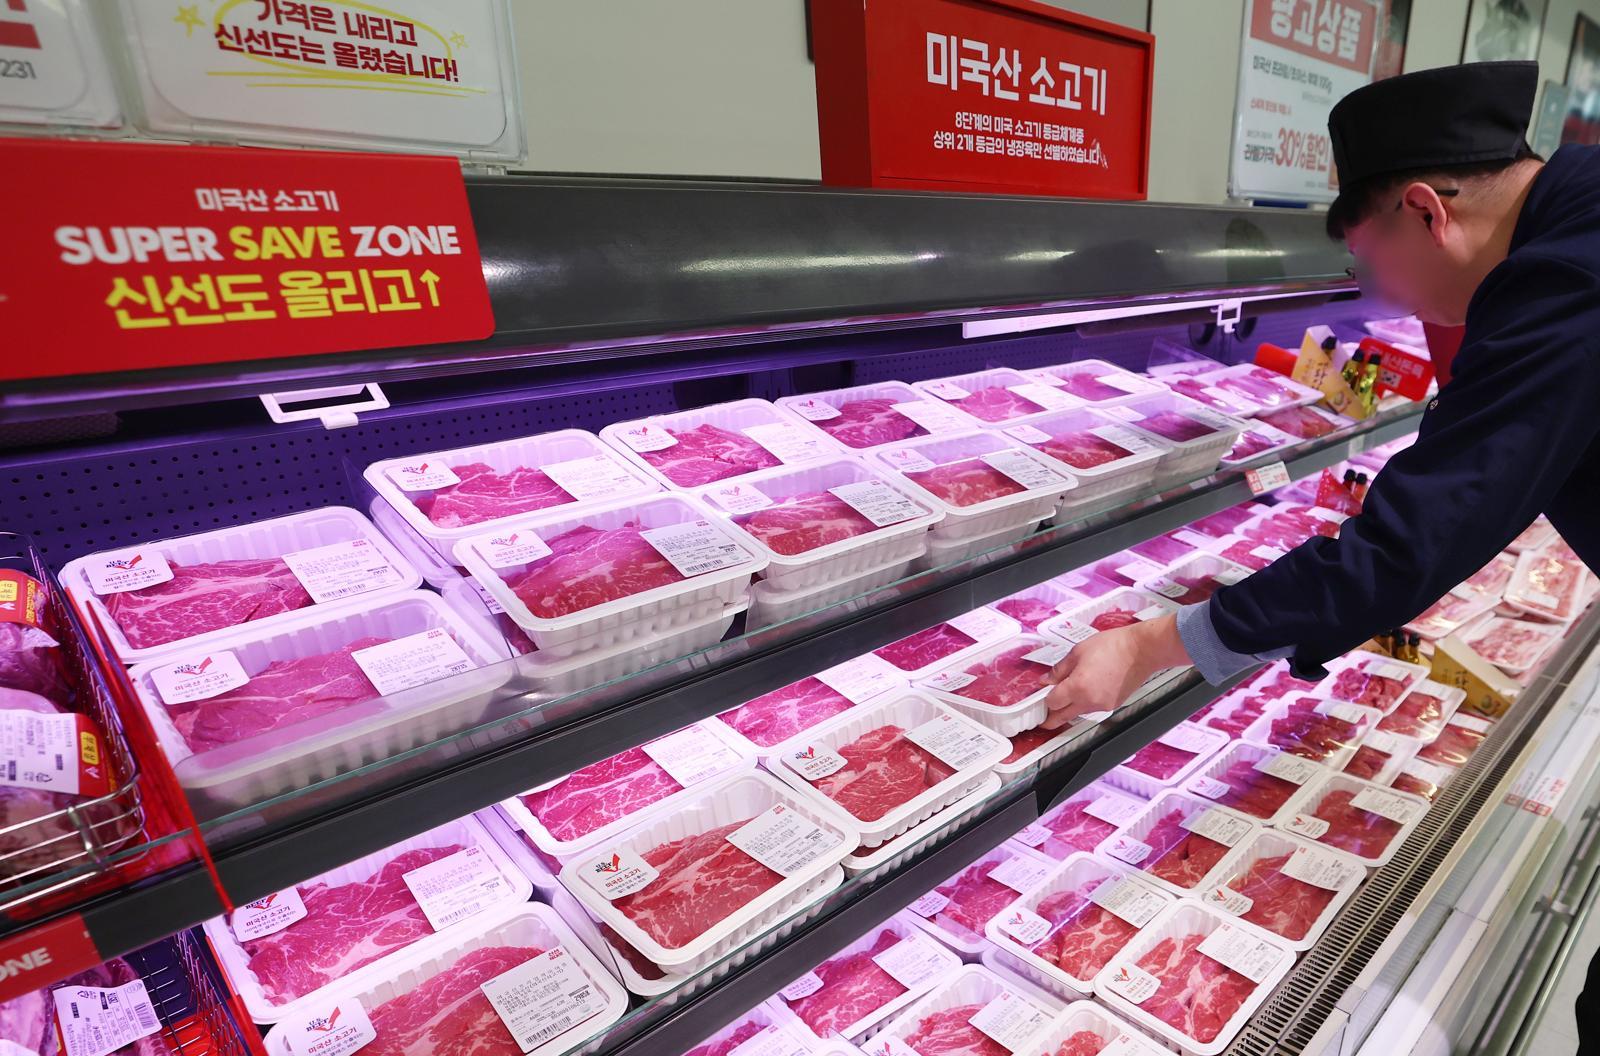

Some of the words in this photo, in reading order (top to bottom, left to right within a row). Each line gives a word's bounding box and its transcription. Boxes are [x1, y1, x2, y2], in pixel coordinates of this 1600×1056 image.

[257, 0, 337, 34] 가격은
[343, 12, 418, 46] 내리고
[215, 24, 326, 64] 신선도는
[333, 41, 458, 82] 올렸습니다!
[926, 32, 1021, 101] 미국산
[1029, 56, 1108, 116] 소고기
[955, 111, 992, 132] 8단계의
[994, 117, 1013, 135] 미국
[1015, 120, 1042, 138] 소고기
[1043, 123, 1084, 144] 등급체계중
[933, 131, 955, 150] 상위
[957, 134, 974, 152] 2개
[976, 136, 1004, 155] 등급의
[1006, 139, 1042, 159] 냉장육만
[1043, 143, 1100, 165] 선별하였습니다
[195, 188, 269, 211] 미국산
[274, 189, 340, 211] 소고기
[54, 225, 224, 265] SUPER
[229, 226, 345, 260] SAVE
[350, 225, 461, 257] ZONE
[105, 273, 277, 329] 신선도
[279, 269, 422, 319] 올리고
[105, 574, 130, 582] 미국산
[132, 569, 156, 578] 소고기
[175, 680, 200, 691] 미국산
[204, 673, 229, 683] 소고기
[605, 877, 624, 888] 미국산
[624, 867, 641, 879] 소고기
[246, 915, 268, 927] 미국산
[270, 906, 291, 918] 소고기
[308, 1039, 332, 1053] 미국산
[334, 1026, 357, 1041] 소고기
